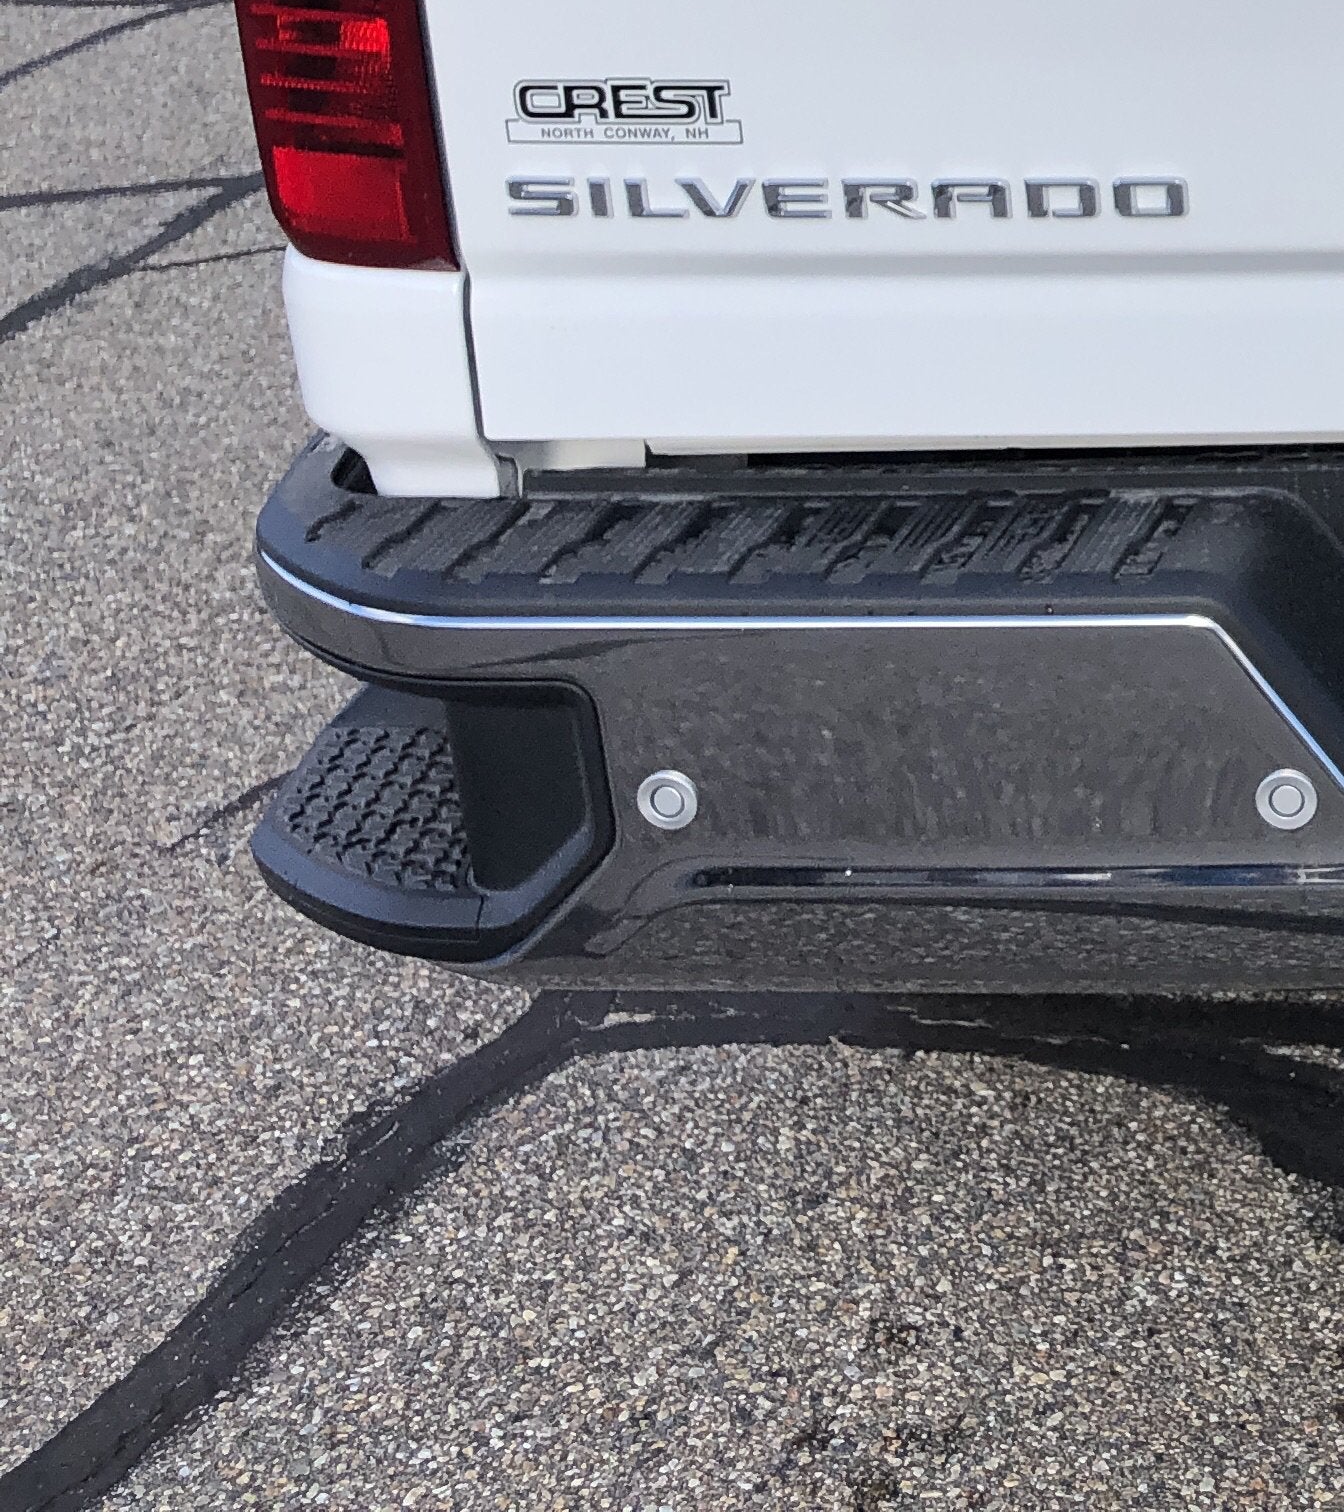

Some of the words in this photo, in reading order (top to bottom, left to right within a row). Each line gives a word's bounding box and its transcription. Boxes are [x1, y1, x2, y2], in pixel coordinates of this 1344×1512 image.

[513, 78, 731, 125] CREST
[541, 126, 594, 139] NORTH
[603, 126, 676, 142] CONWAY,
[685, 126, 710, 139] NH
[506, 175, 1191, 220] SILVERADO
